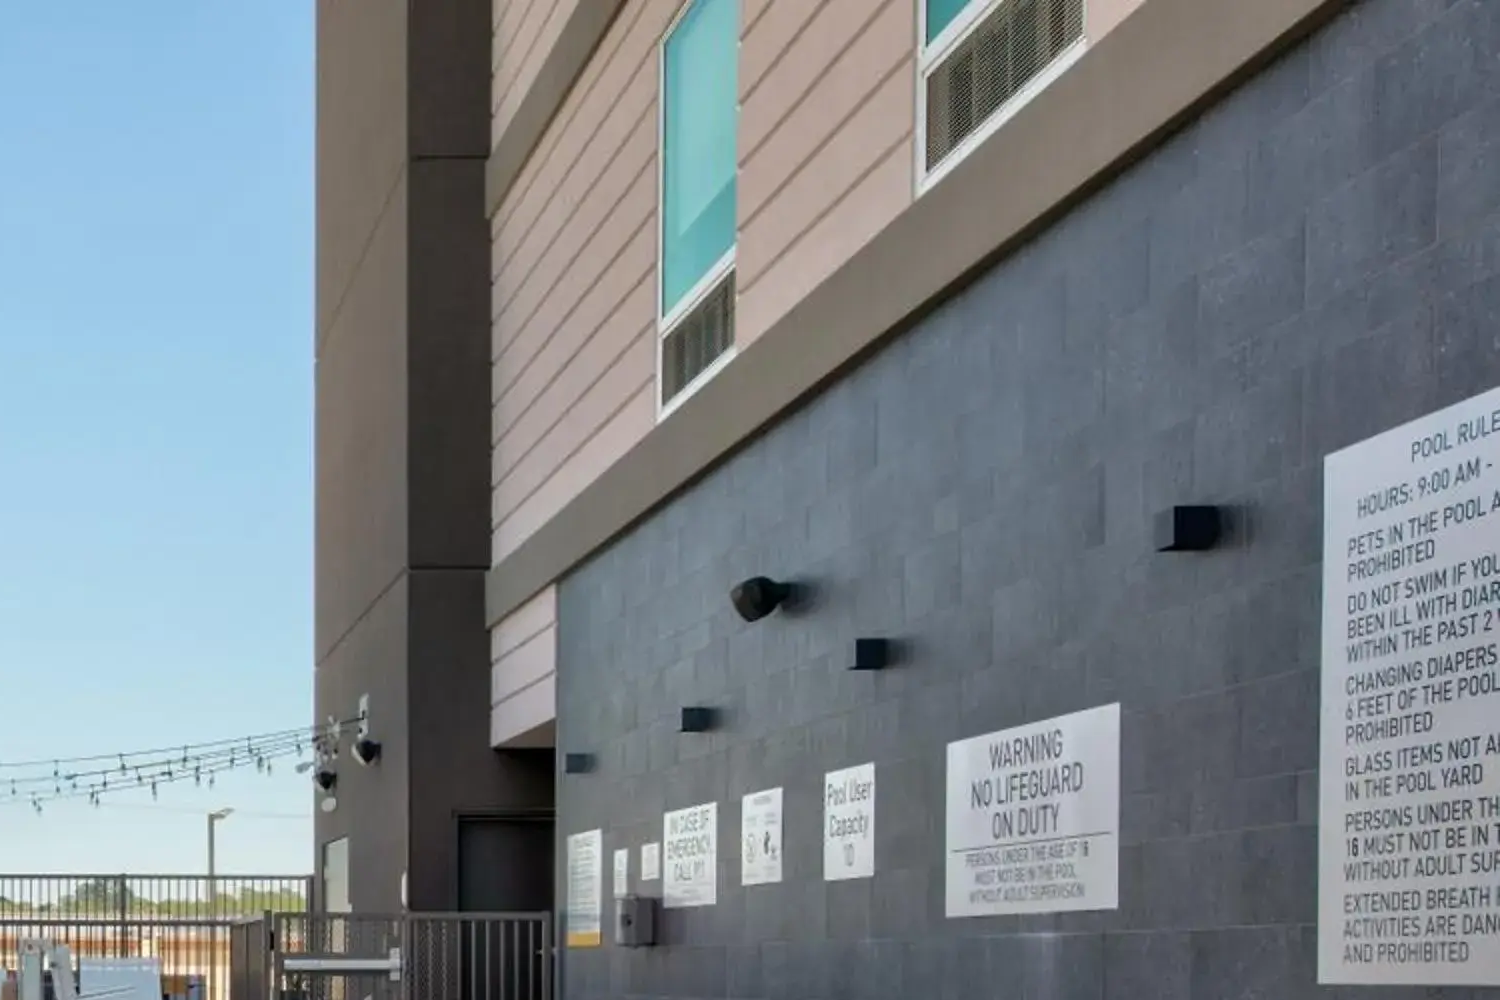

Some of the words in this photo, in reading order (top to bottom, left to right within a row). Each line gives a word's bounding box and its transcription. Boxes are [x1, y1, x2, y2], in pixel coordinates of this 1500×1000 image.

[1411, 429, 1453, 463] POOL
[1357, 483, 1414, 520] HOURS:
[1417, 467, 1450, 498] 9:00
[1453, 455, 1481, 487] AM
[1347, 528, 1384, 559] PETS
[1389, 521, 1403, 545] IN
[1408, 510, 1438, 538] THE
[1443, 495, 1487, 529] POOL
[1347, 539, 1435, 583] PROHIBITED
[1347, 591, 1367, 616] DO
[1371, 581, 1401, 608] NOT
[1404, 568, 1448, 600] SWIM
[1452, 561, 1467, 585] IF
[1347, 611, 1385, 640] BEEN
[1389, 605, 1412, 628] ILL
[1416, 591, 1457, 621] WITH
[1346, 633, 1398, 665] WITHIN
[1402, 624, 1433, 650] THE
[1437, 612, 1479, 643] PAST
[1483, 609, 1493, 632] 2
[1345, 660, 1423, 696] CHANGING
[1427, 642, 1498, 679] DIAPERS
[1345, 703, 1354, 721] 6
[1357, 693, 1394, 719] FEET
[1397, 686, 1417, 711] OF
[1421, 680, 1453, 706] THE
[1457, 671, 1500, 699] POOL
[1345, 711, 1434, 746] PROHIBITED
[989, 728, 1064, 771] WARNING
[1345, 751, 1393, 778] GLASS
[1397, 742, 1443, 769] ITEMS
[1448, 735, 1481, 761] NOT
[828, 780, 846, 806] Pool
[850, 777, 871, 803] User
[970, 779, 993, 810] NO
[996, 761, 1084, 805] LIFEGUARD
[1345, 781, 1359, 801] IN
[1364, 775, 1392, 799] THE
[1396, 770, 1437, 795] POOL
[1441, 763, 1484, 789] YARD
[830, 812, 869, 839] Capacity
[992, 811, 1013, 840] ON
[1017, 802, 1060, 837] DUTY
[1345, 805, 1413, 833] PERSONS
[1417, 799, 1473, 825] UNDER
[1346, 837, 1359, 857] 16
[1363, 832, 1405, 856] MUST
[1409, 828, 1440, 851] NOT
[1445, 827, 1467, 849] BE
[1471, 823, 1489, 847] IN
[1344, 857, 1410, 882] WITHOUT
[1414, 853, 1467, 878] ADULT
[1343, 889, 1421, 914] EXTENDED
[1426, 886, 1491, 910] BREATH
[1342, 915, 1421, 940] ACTIVITIES
[1424, 913, 1457, 938] ARE
[1343, 944, 1373, 965] AND
[1377, 941, 1469, 964] PROHIBITED
